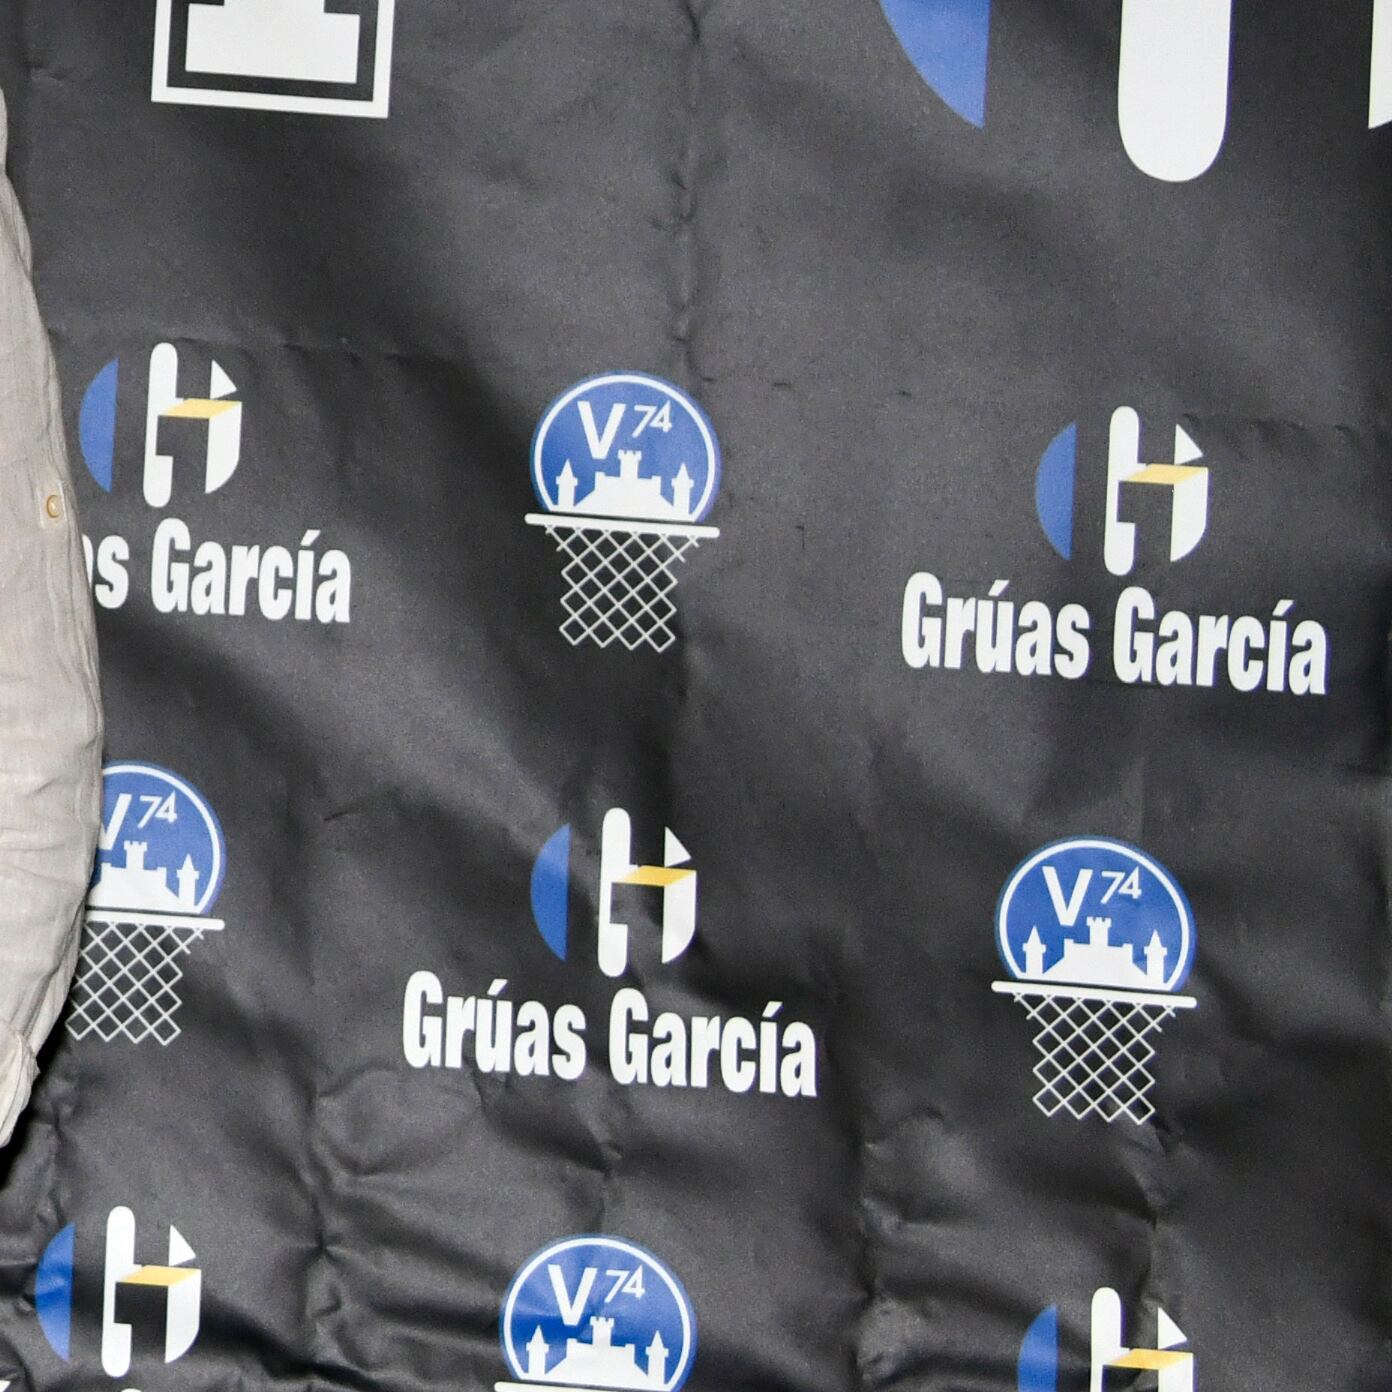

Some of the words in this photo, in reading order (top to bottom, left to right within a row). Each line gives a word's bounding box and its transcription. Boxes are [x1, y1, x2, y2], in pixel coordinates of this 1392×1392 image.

[151, 518, 351, 623] García
[901, 571, 1090, 680] Grúas
[1113, 586, 1326, 695] García
[402, 970, 586, 1080] Grúas
[609, 987, 817, 1097] García
